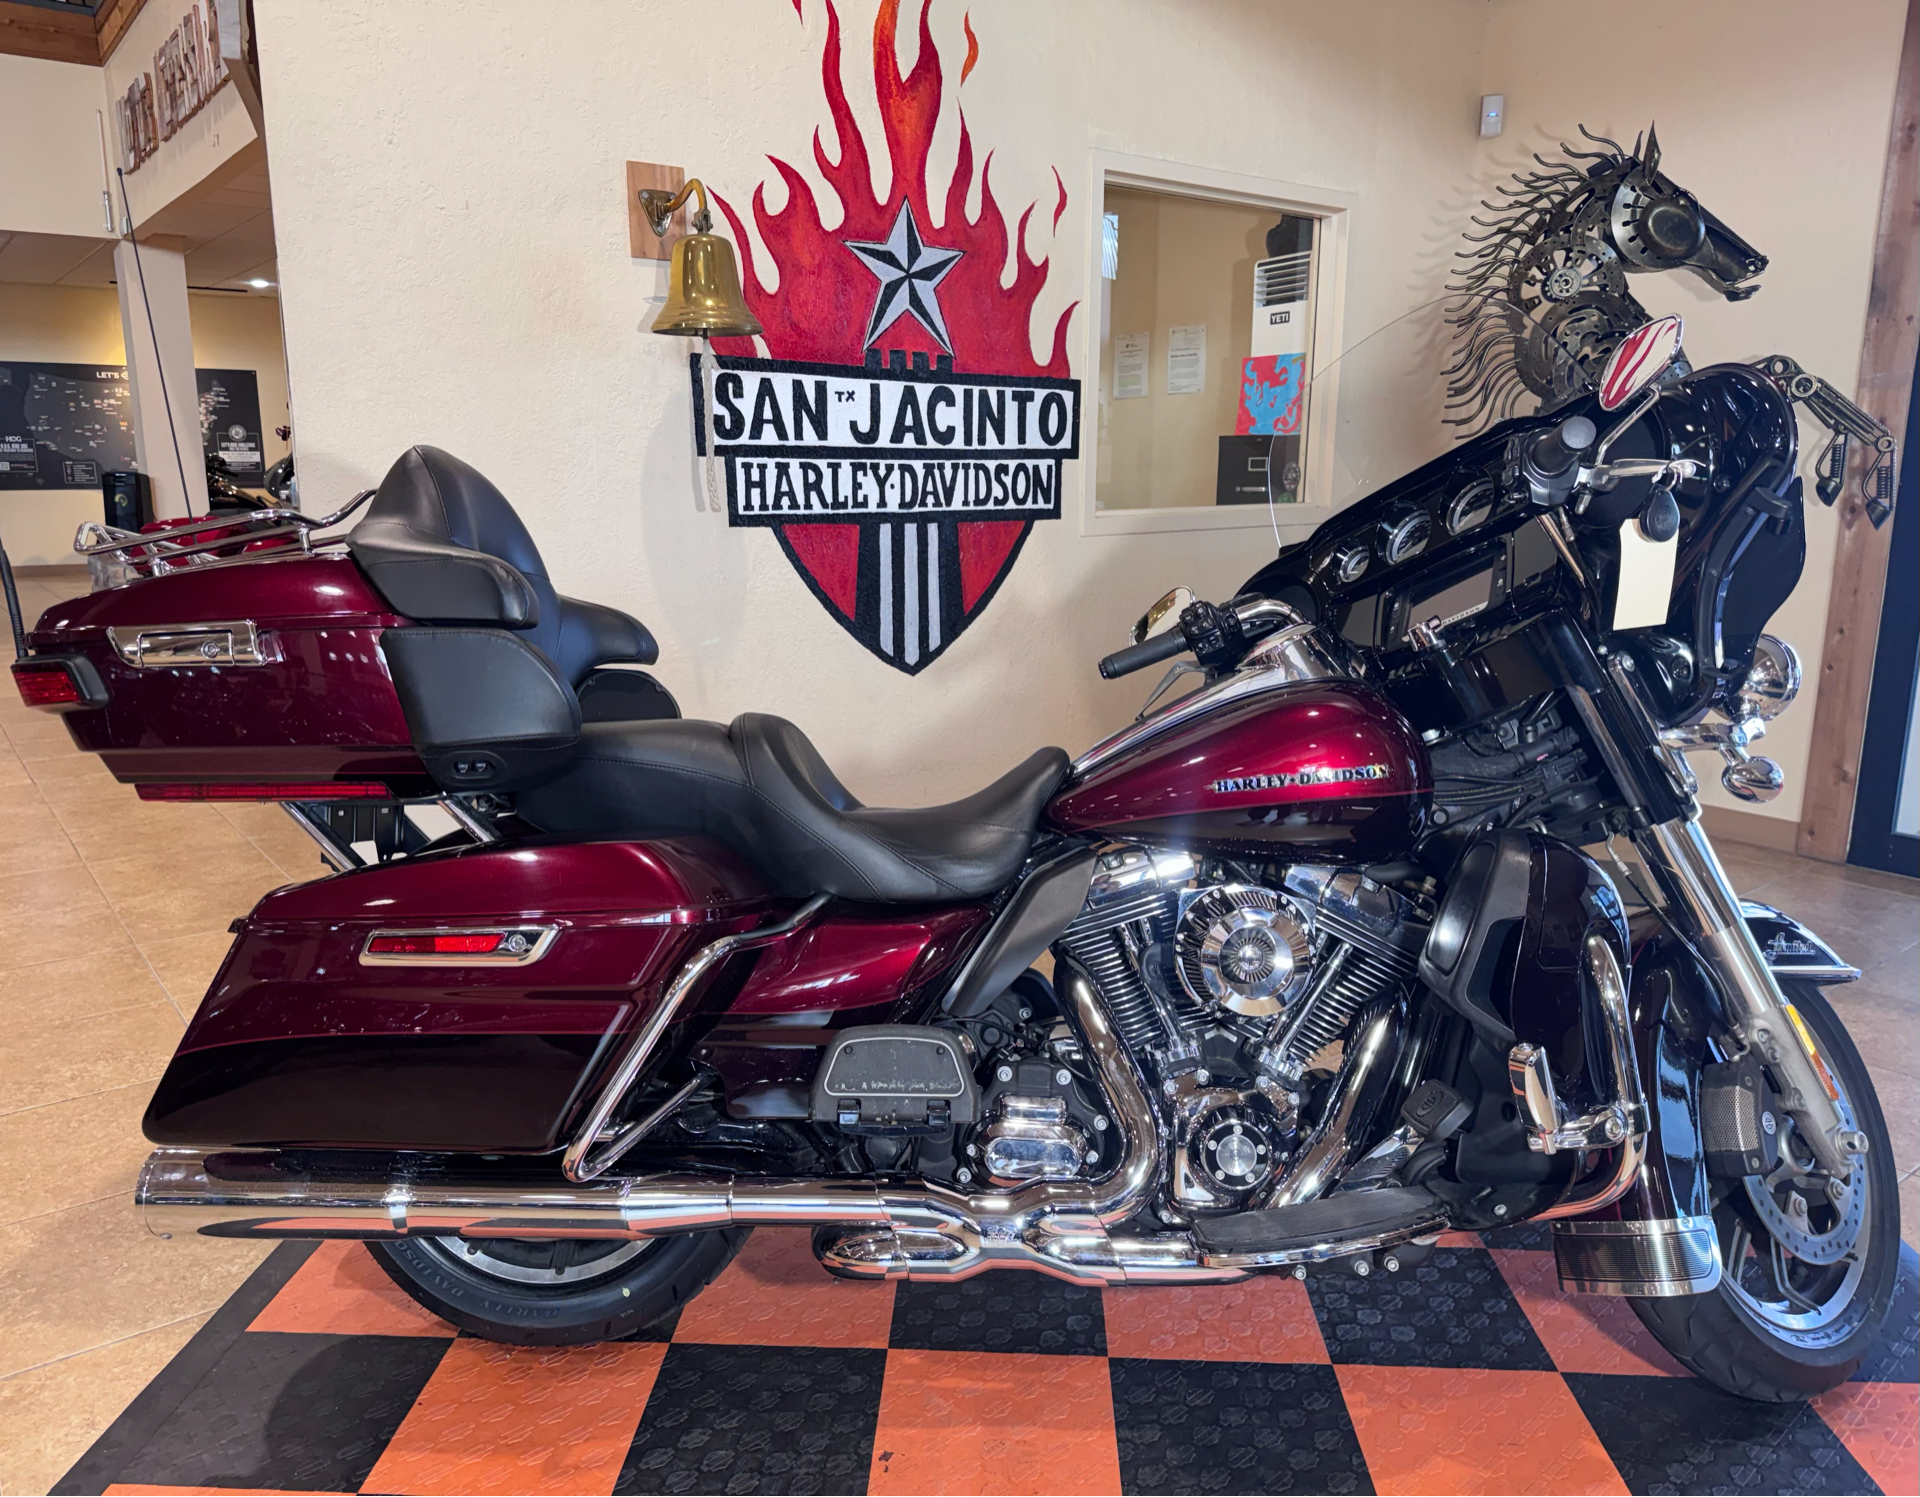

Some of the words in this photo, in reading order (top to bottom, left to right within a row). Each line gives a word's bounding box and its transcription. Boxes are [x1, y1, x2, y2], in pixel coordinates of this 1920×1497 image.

[1271, 313, 1289, 323] YETI
[96, 371, 120, 379] LET'S
[713, 372, 828, 442] SAN
[834, 389, 857, 403] TX
[849, 382, 1068, 447] JACINTO
[1442, 606, 1480, 626] DAVIDSON
[394, 1240, 464, 1298] DAVIDSO
[481, 1299, 560, 1318] HARLEY
